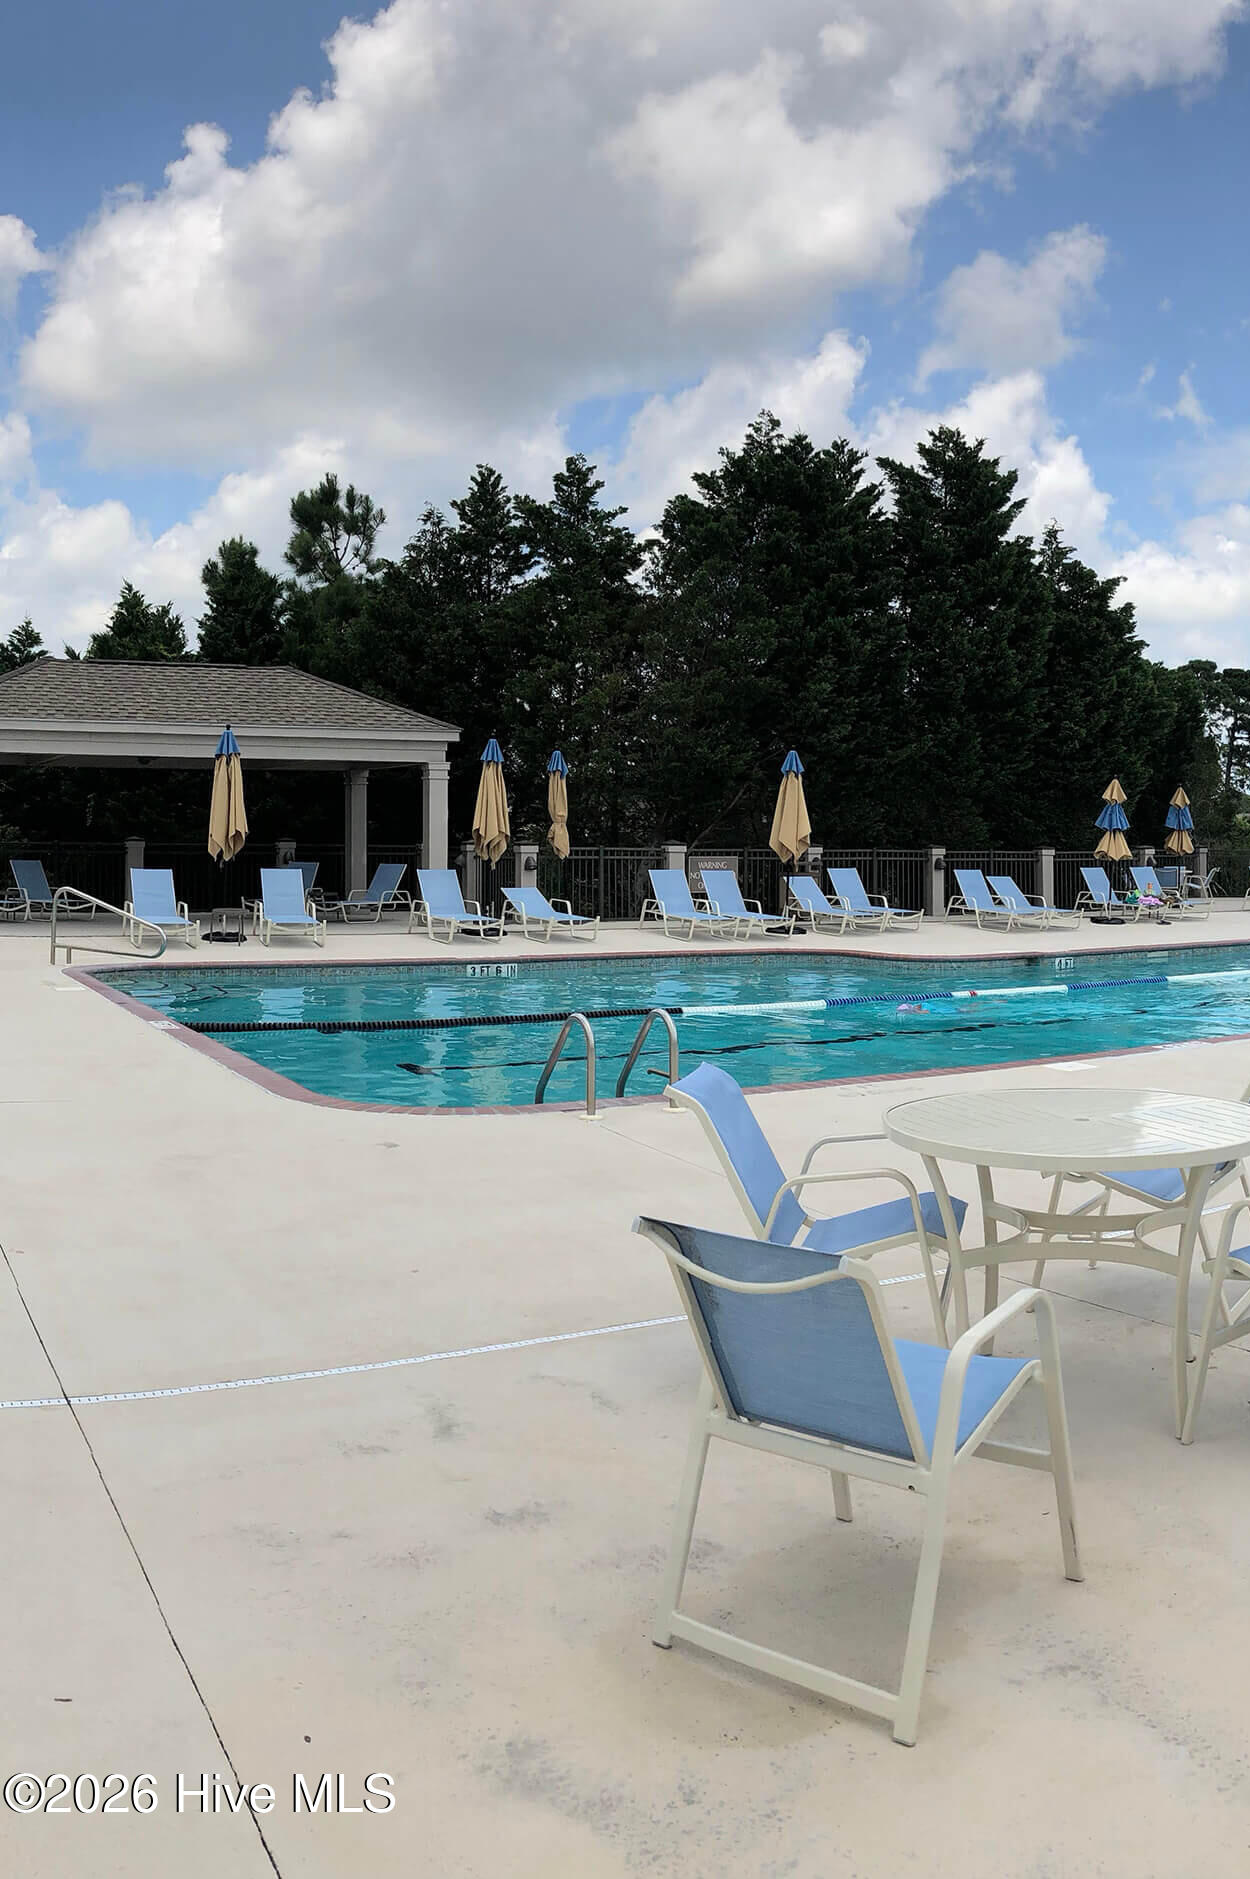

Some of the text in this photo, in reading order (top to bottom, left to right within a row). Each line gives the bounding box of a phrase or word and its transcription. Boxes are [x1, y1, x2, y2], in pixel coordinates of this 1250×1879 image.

[697, 861, 728, 869] WARNING
[690, 871, 701, 880] NO
[480, 965, 490, 977] FT
[506, 965, 517, 977] IN
